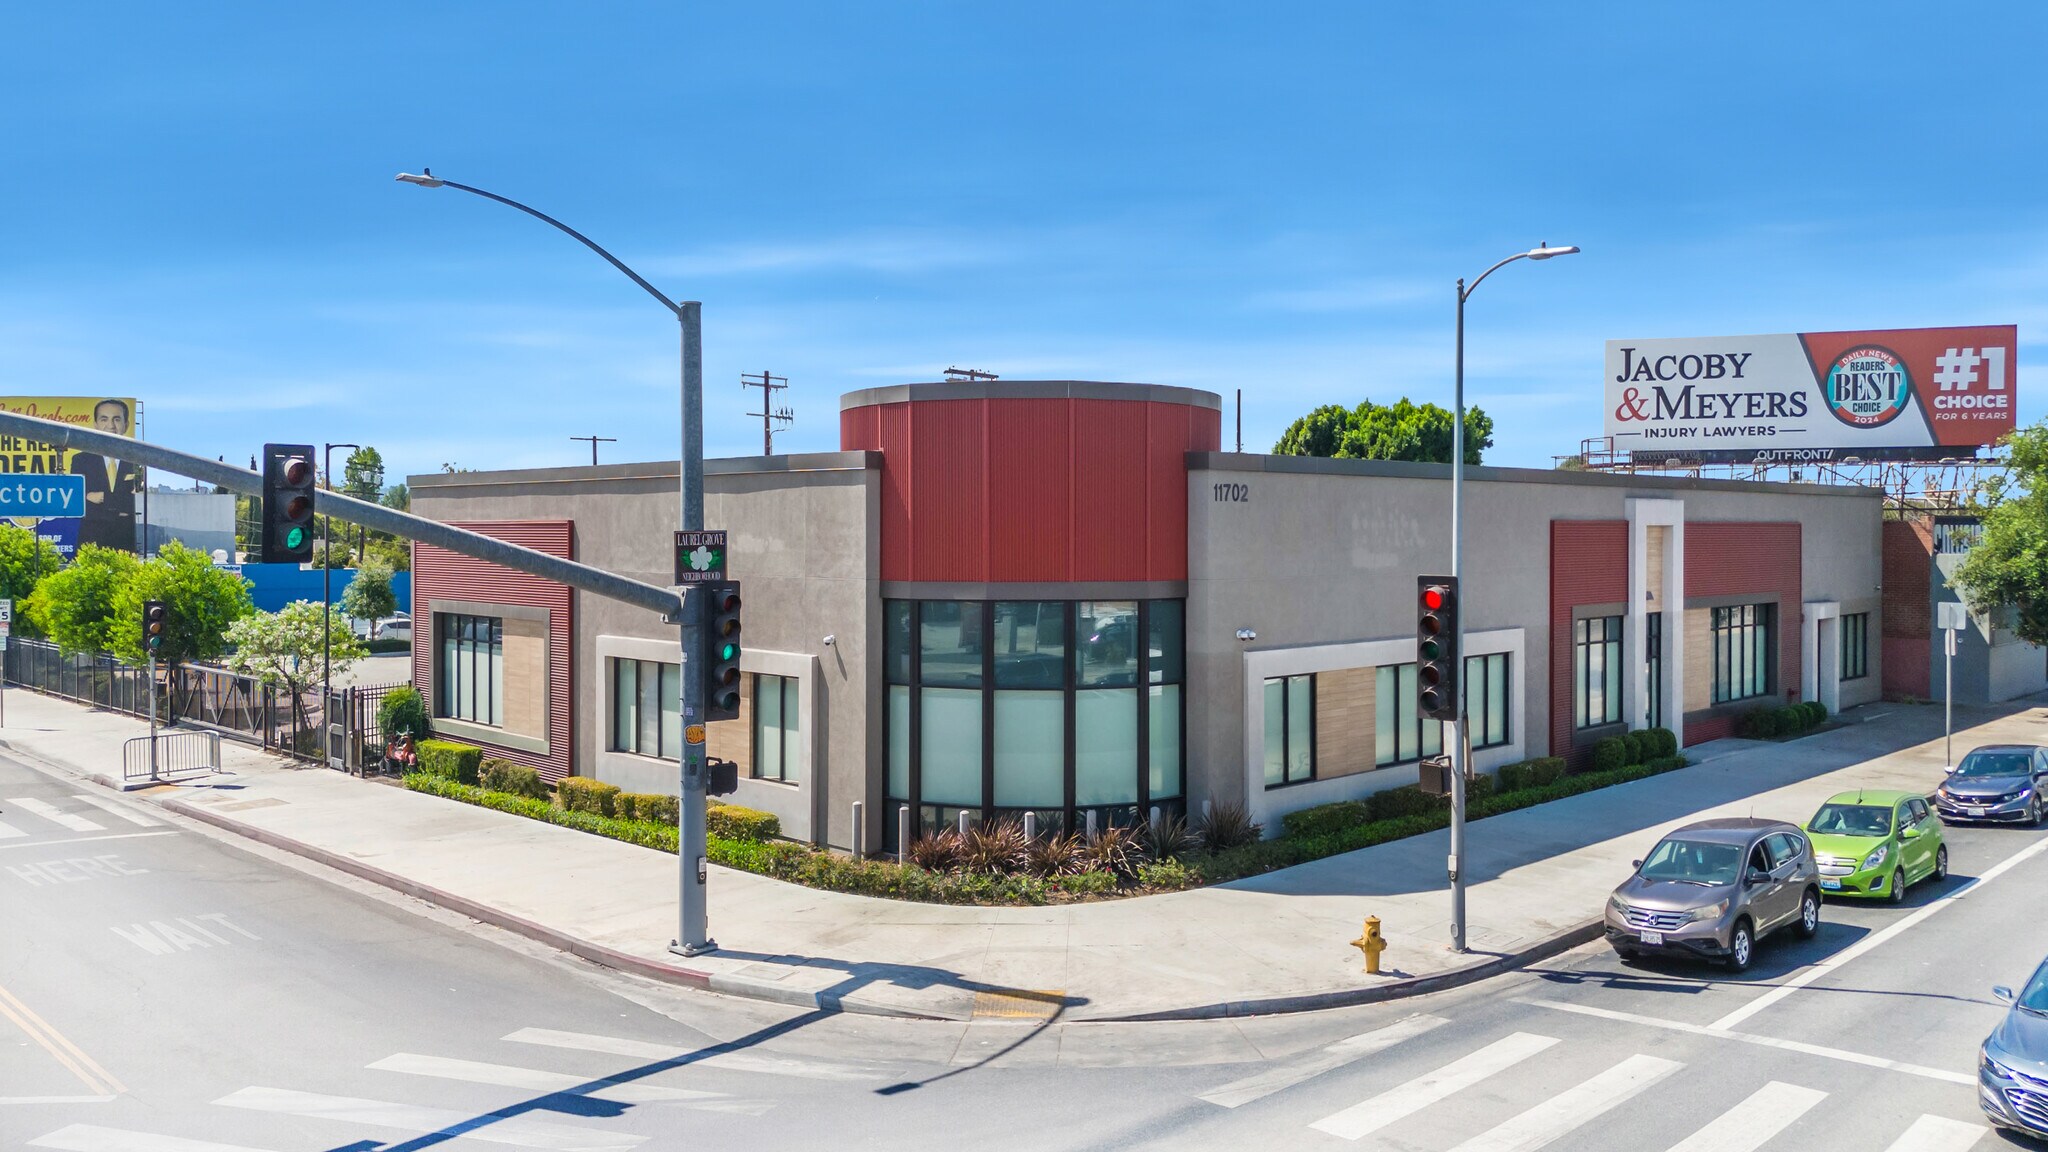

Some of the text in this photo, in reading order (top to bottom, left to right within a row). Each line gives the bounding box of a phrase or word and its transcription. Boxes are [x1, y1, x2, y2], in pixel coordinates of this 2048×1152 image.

[1616, 348, 1752, 382] JACOBY
[1841, 350, 1893, 365] DAILY NEWS
[1850, 361, 1886, 371] READERS
[1933, 347, 2006, 391] #1
[1834, 372, 1901, 402] BEST
[1652, 385, 1808, 420] MEYERS
[1852, 402, 1882, 413] CHOICE
[1934, 394, 2008, 409] CHOICE
[1854, 416, 1879, 424] 2024
[1935, 411, 2008, 421] FOR 6 YEARS
[1644, 425, 1776, 439] INJURY LAWYERS
[1213, 483, 1249, 503] 11702
[677, 533, 725, 546] LAUREL GROVE
[5, 854, 151, 887] HERE
[109, 912, 263, 956] WAIT
